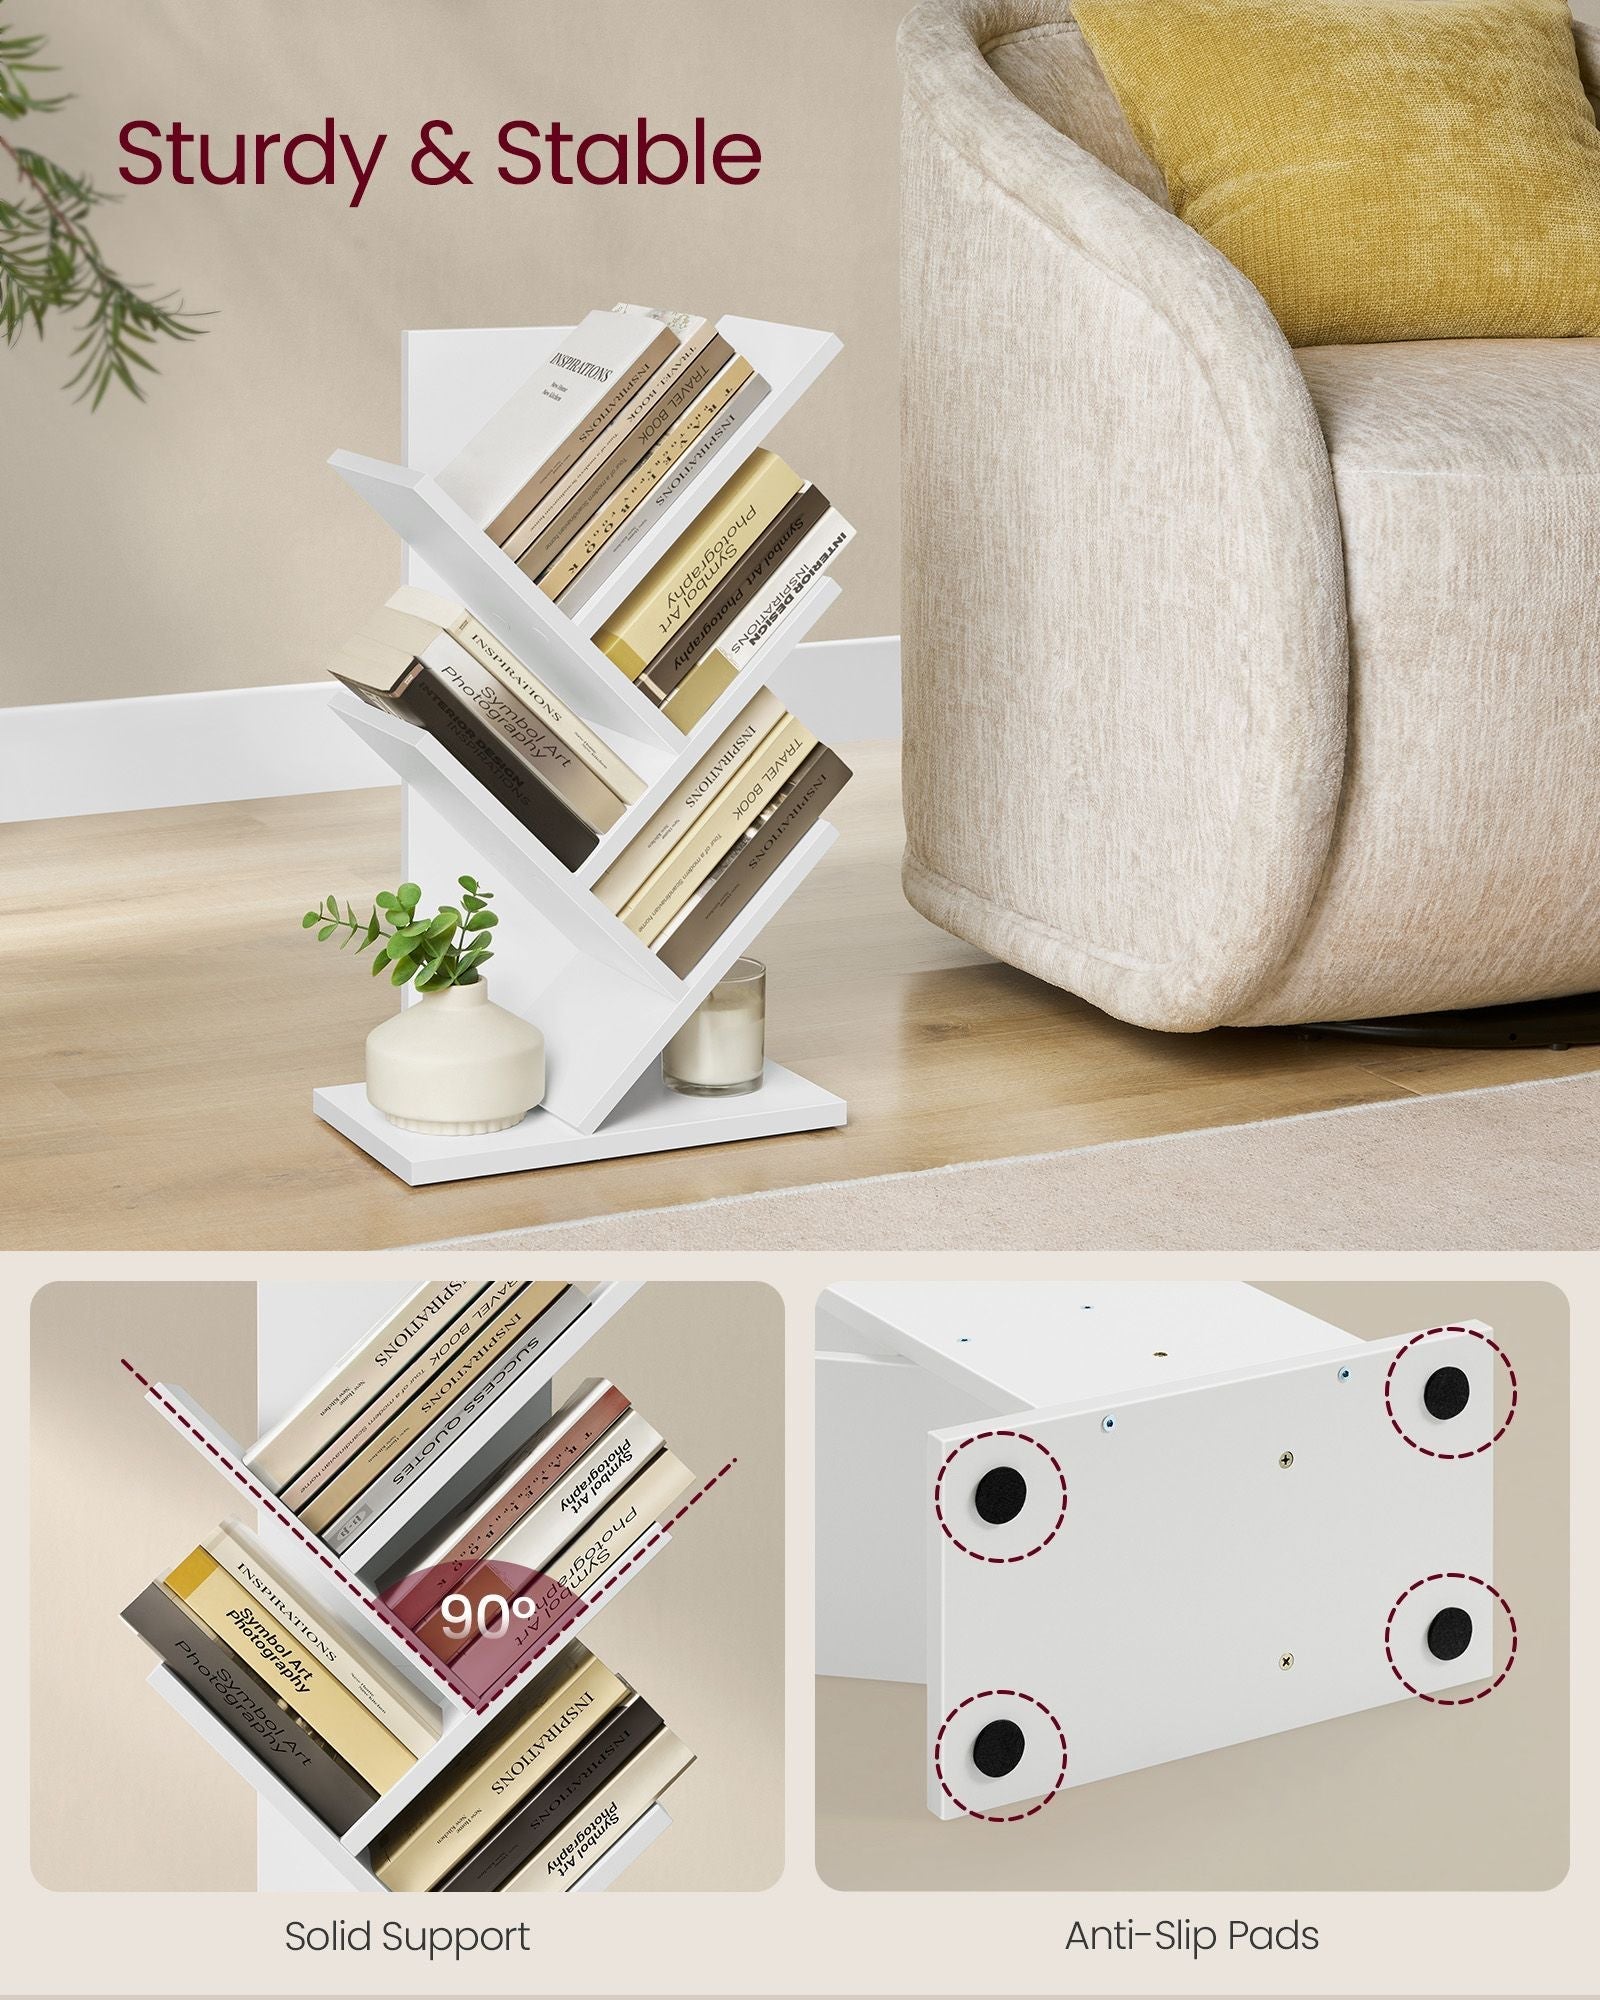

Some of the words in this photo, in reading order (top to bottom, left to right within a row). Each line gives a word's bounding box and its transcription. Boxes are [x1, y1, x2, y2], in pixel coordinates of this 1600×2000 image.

[550, 352, 613, 383] INSPIRATIONS
[656, 347, 696, 386] TRAVEL
[662, 365, 710, 408] TRAVEL
[579, 363, 650, 442] INSPIRATIONS
[627, 389, 657, 422] BOOK
[638, 408, 669, 445] BOOK
[656, 414, 735, 506] INSPIRATIONS
[568, 504, 630, 574] BOOK
[668, 504, 756, 609] Photography
[764, 518, 804, 566] Symbol
[790, 532, 847, 594] INTERIOR
[683, 541, 738, 608] Symbol
[746, 563, 762, 586] Art
[658, 604, 680, 633] Art
[674, 588, 744, 671] Photography
[731, 564, 809, 654] INSPIRATIONS
[748, 590, 795, 646] DESIGN
[472, 634, 562, 722] INSPIRATIONS
[418, 681, 476, 740] INTERIOR
[474, 738, 524, 788] DESIGN
[441, 666, 547, 758] Photography
[480, 686, 546, 742] Symbol
[542, 746, 571, 768] Art
[446, 718, 531, 806] INSPIRATIONS
[685, 725, 756, 808] INSPIRATIONS
[761, 738, 803, 782] TRAVEL
[732, 783, 764, 820] BOOK
[748, 774, 826, 869] INSPIRATIONS
[682, 857, 702, 880] modern
[704, 845, 711, 855] of
[709, 833, 722, 847] Tour
[638, 914, 654, 933] home
[421, 1313, 522, 1413] INSPIRATIONS
[429, 1322, 470, 1366] BOOK
[464, 1337, 539, 1414] SUCCESS
[400, 1383, 409, 1394] of
[409, 1368, 425, 1385] Tour
[367, 1398, 395, 1426] modern
[321, 1425, 368, 1472] Scandinavian
[392, 1416, 461, 1485] QUOTES
[561, 1438, 631, 1512] Photography
[585, 1447, 633, 1496] Symbol
[300, 1471, 321, 1493] home
[571, 1492, 589, 1514] Art
[237, 1562, 337, 1662] INSPIRATIONS
[539, 1545, 610, 1618] Symbol
[226, 1610, 310, 1692] Photography
[235, 1608, 292, 1658] Symbol
[288, 1660, 313, 1681] Art
[514, 1616, 539, 1646] Art
[174, 1640, 287, 1752] Photography
[212, 1668, 285, 1740] Symbol
[282, 1740, 312, 1766] Art
[491, 1691, 595, 1795] INSPIRATIONS
[530, 1730, 630, 1830] INSPIRATIONS
[547, 1801, 618, 1875] Photography
[557, 1855, 575, 1876] Art
[577, 1810, 619, 1859] Symbol
